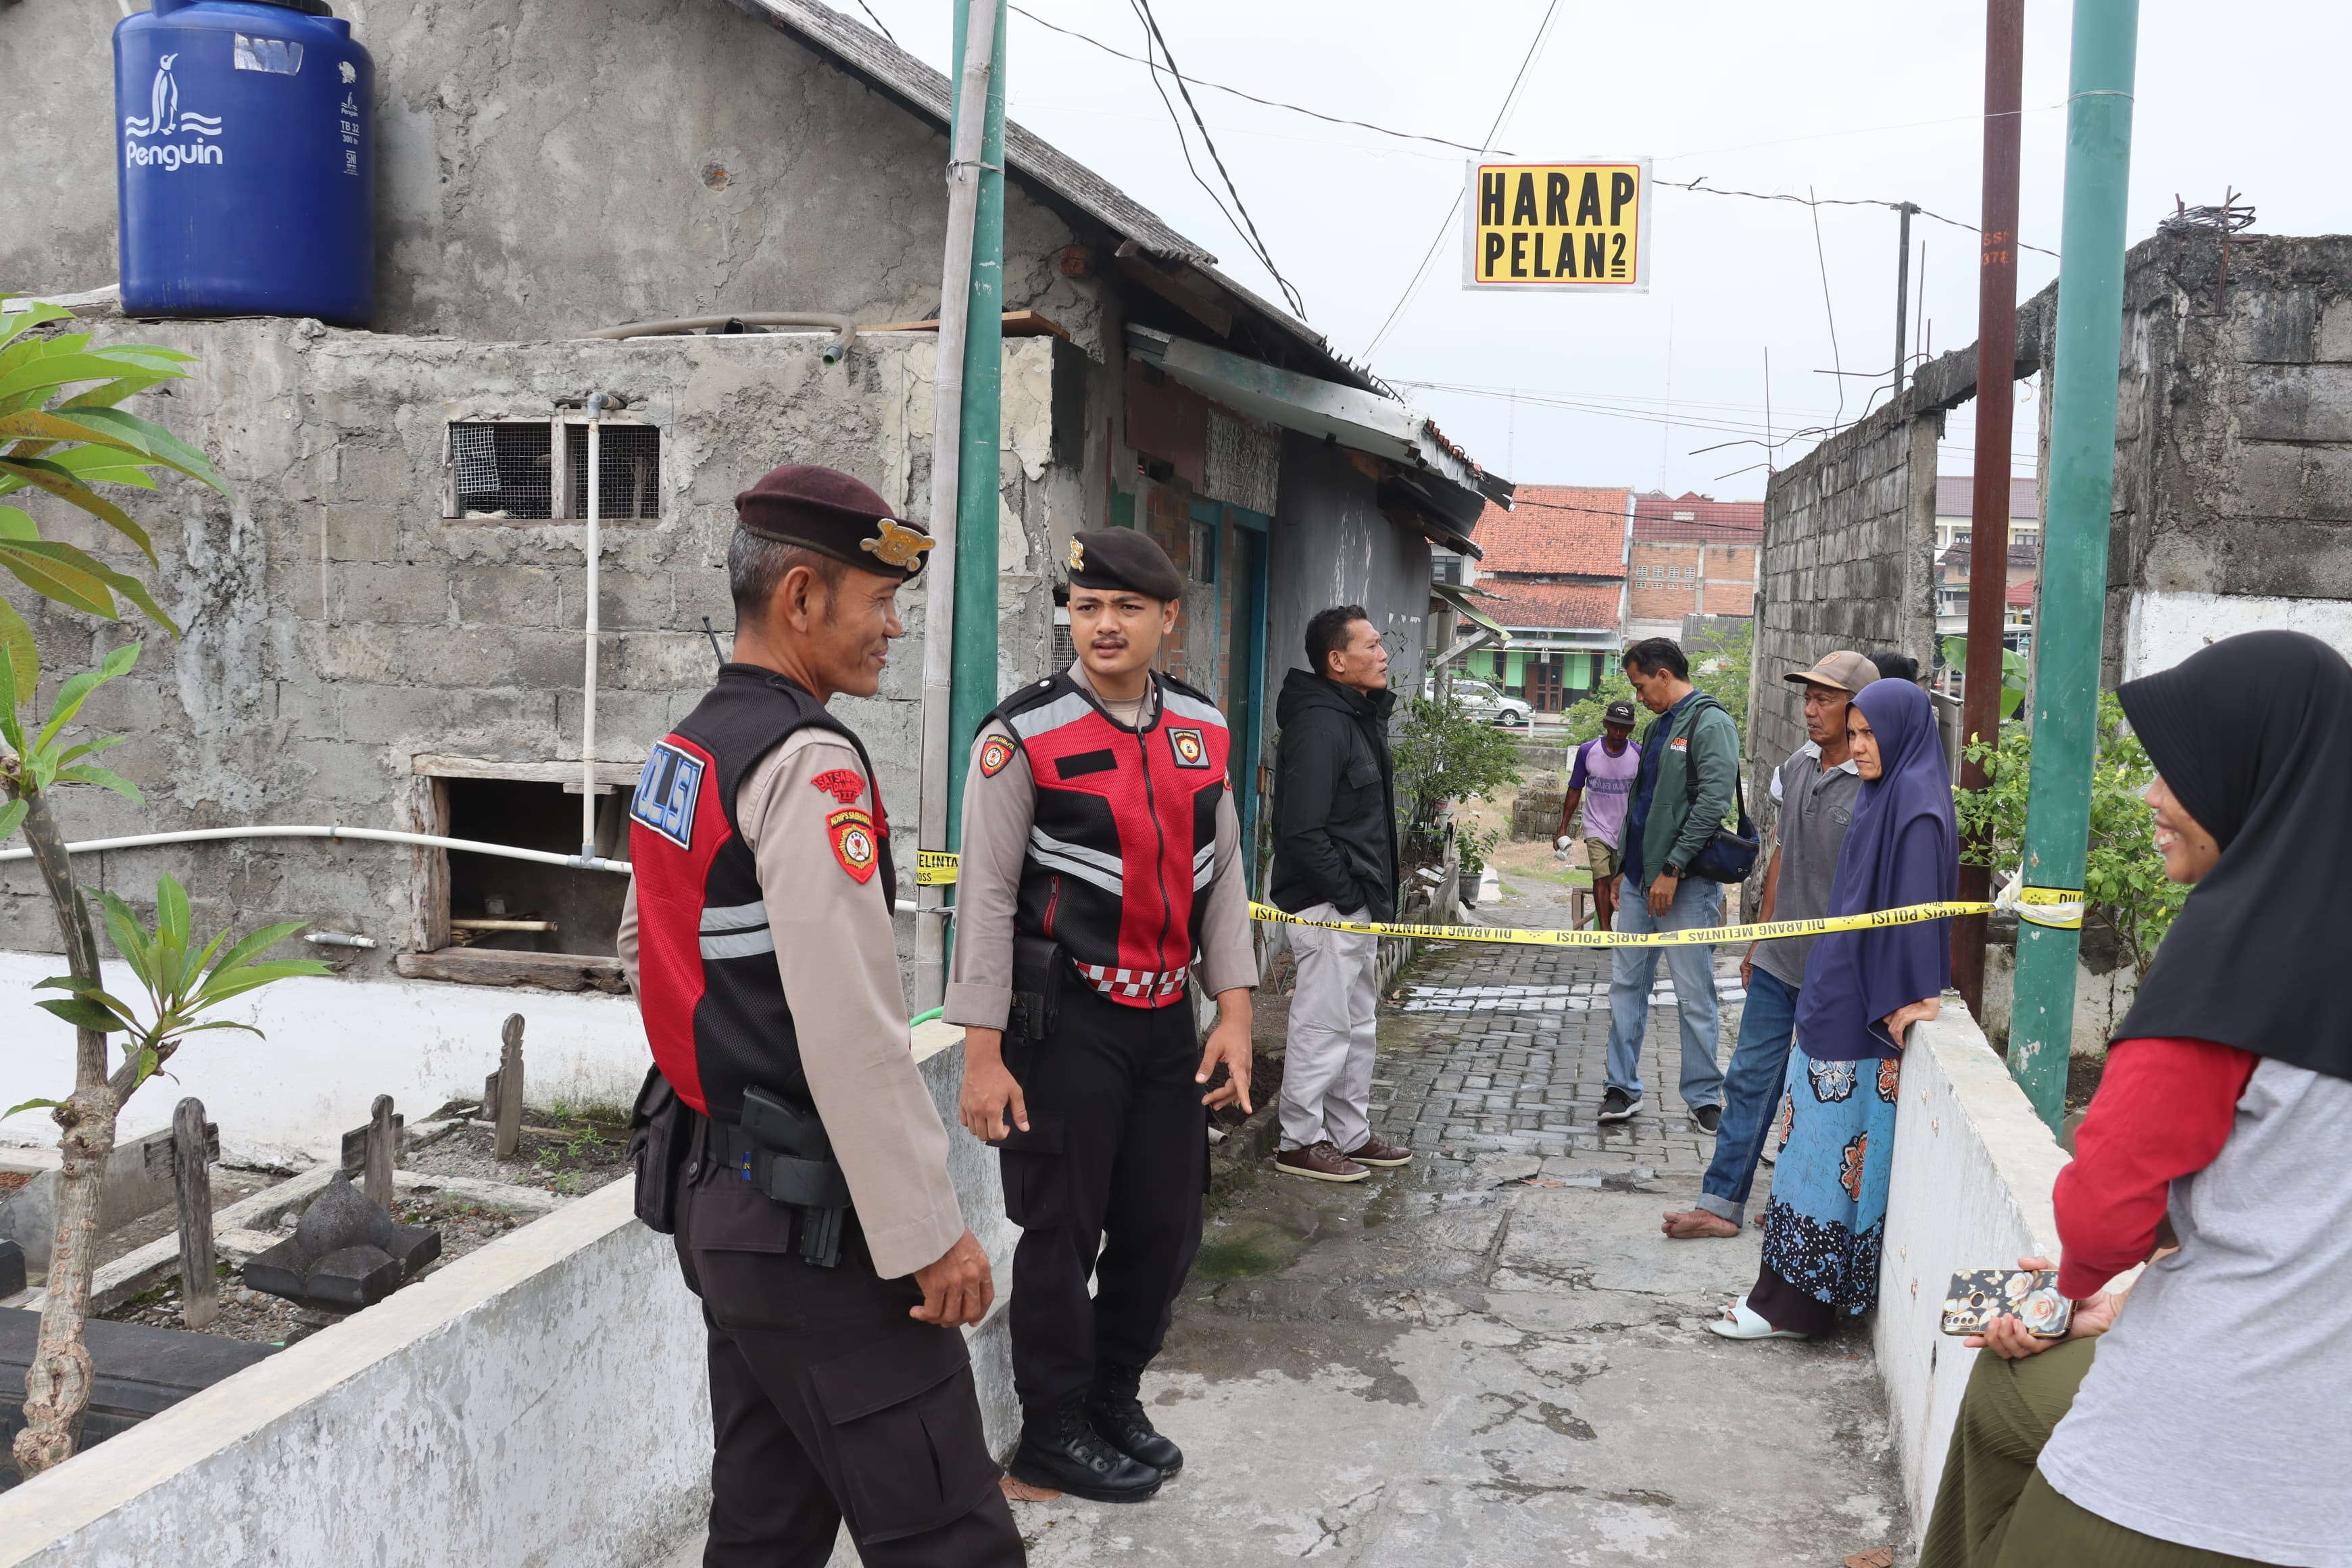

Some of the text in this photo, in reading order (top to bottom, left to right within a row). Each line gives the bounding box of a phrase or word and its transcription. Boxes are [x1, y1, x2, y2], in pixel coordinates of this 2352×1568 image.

[341, 120, 360, 133] TB 32
[342, 134, 353, 144] 300
[126, 137, 223, 171] Penguin
[346, 152, 357, 165] SNI
[1481, 172, 1635, 226] HARAP
[817, 773, 835, 788] SAT
[1871, 908, 1918, 925] POLISI
[1380, 923, 1442, 936] MELINTAS
[1448, 926, 1512, 939] DILARANG
[1759, 919, 1825, 935] DILARANG
[1557, 932, 1601, 944] POLISI
[1608, 933, 1648, 944] GARIS
[1689, 929, 1753, 941] MELINTAS
